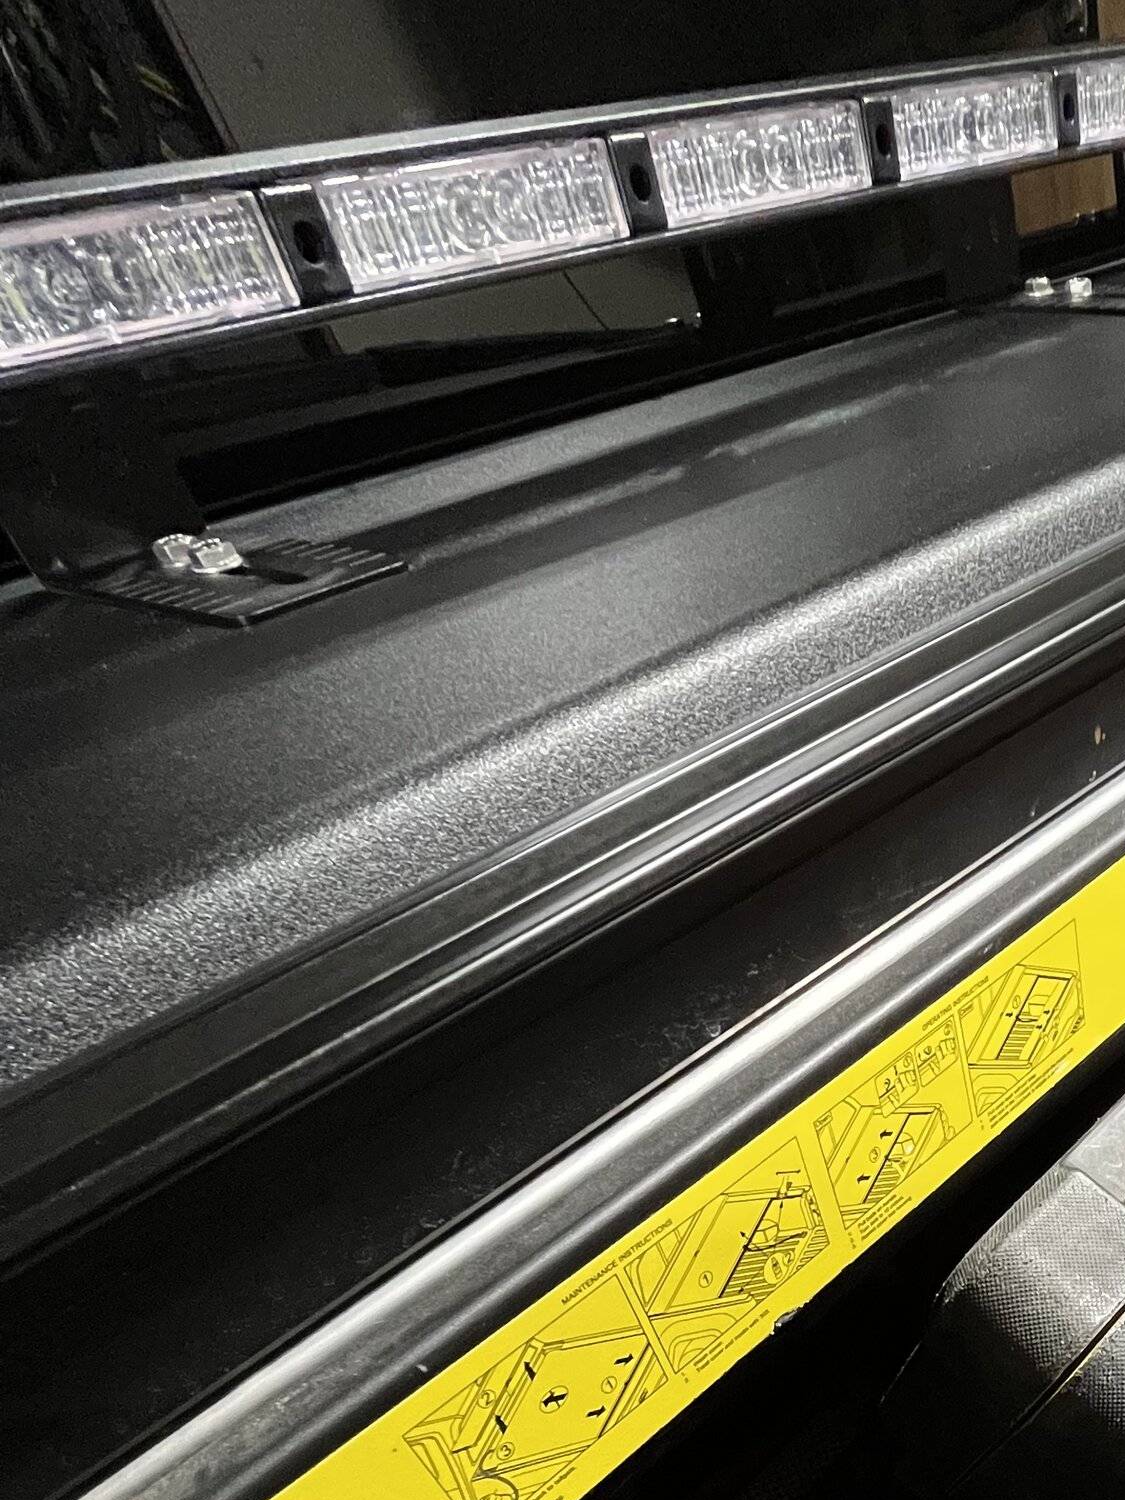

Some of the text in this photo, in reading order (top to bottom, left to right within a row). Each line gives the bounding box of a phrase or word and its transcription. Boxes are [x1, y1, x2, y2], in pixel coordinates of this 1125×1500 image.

[922, 1005, 952, 1031] OPERATING
[952, 976, 989, 1008] INSTRUCTIONS
[561, 1219, 673, 1305] MAINTENANCE INSTRUCTIONS
